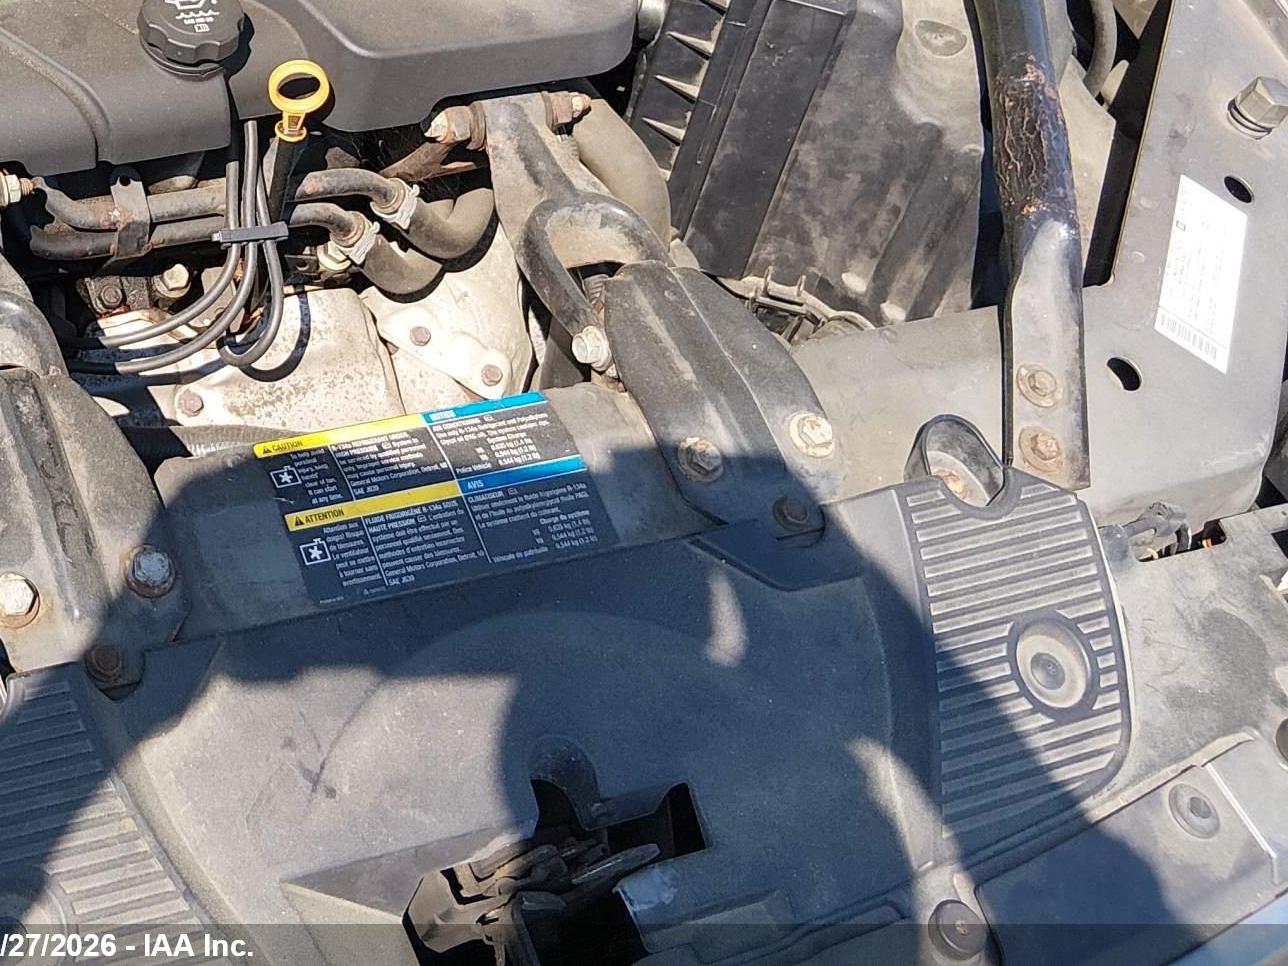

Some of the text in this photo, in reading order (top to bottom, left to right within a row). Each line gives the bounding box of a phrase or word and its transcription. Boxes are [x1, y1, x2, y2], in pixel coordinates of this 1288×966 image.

[271, 439, 303, 451] CAUTION
[349, 477, 371, 486] General
[370, 474, 390, 482] Motors
[465, 479, 485, 489] AVIS
[303, 508, 345, 523] ATTENTION
